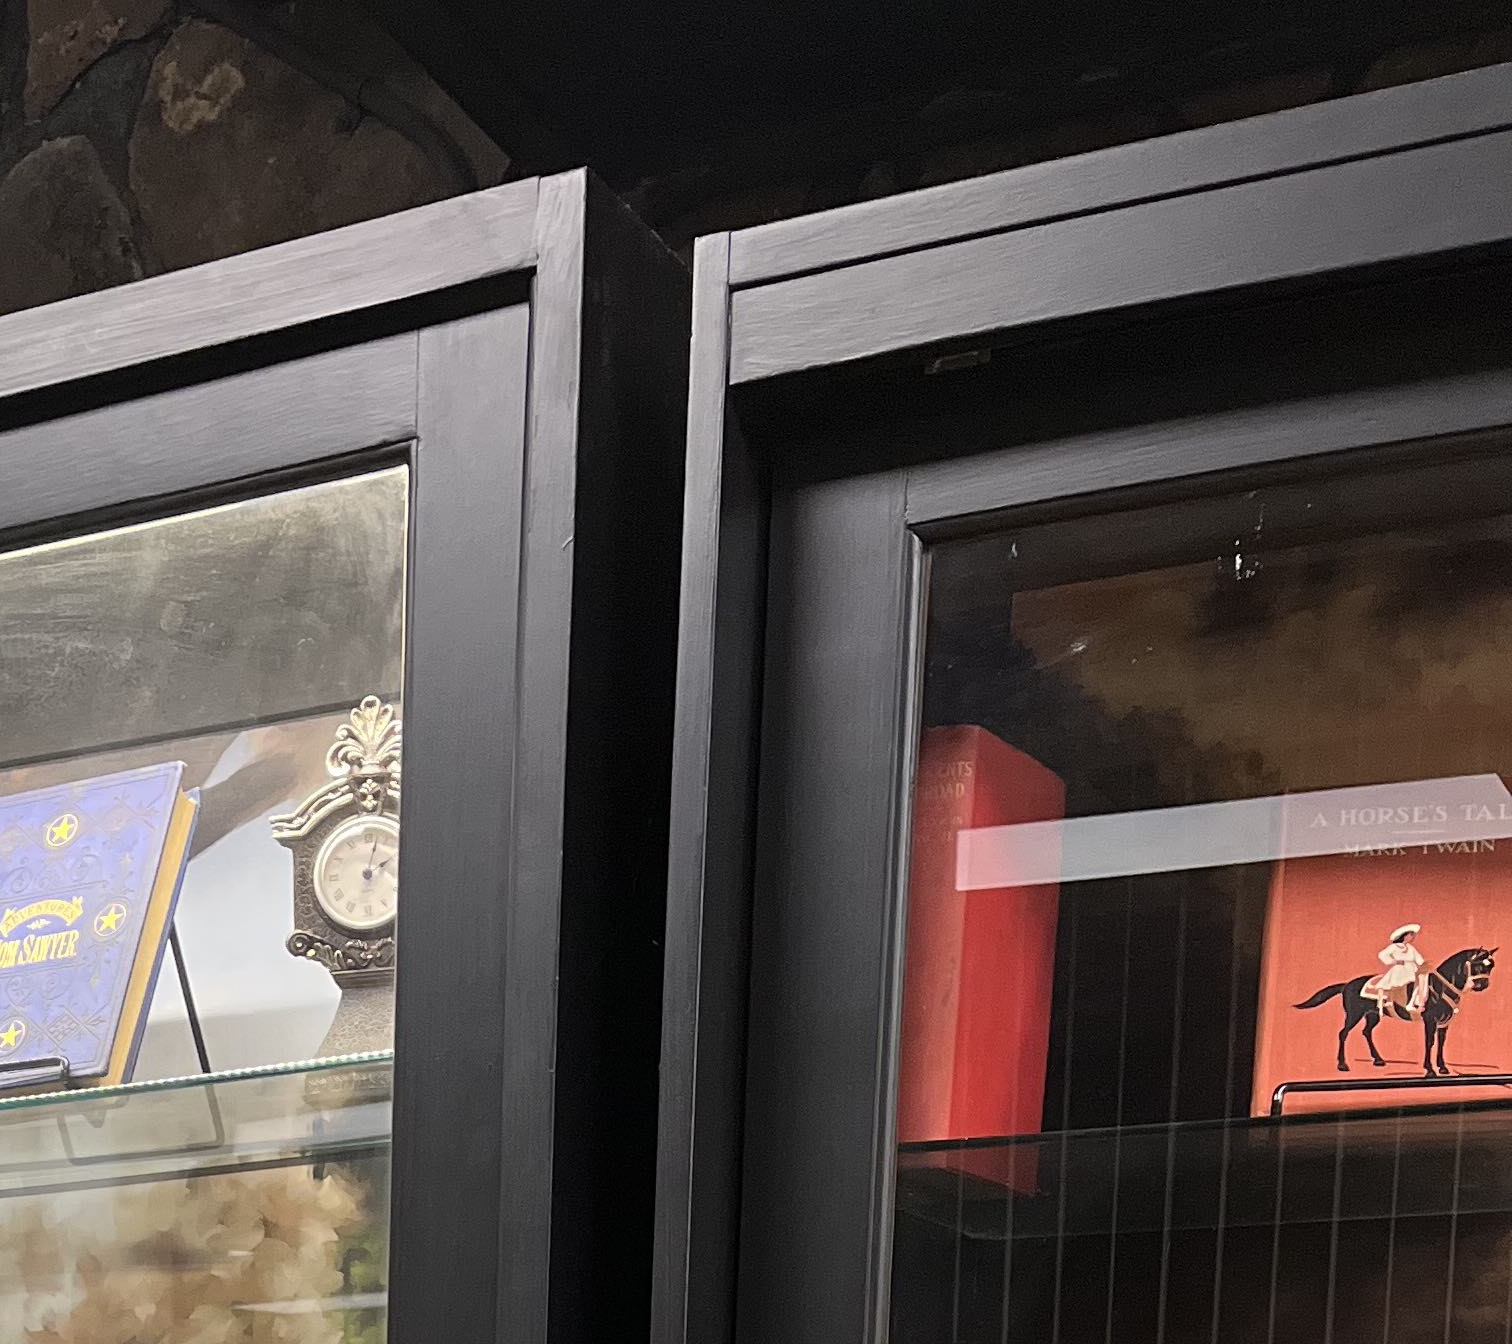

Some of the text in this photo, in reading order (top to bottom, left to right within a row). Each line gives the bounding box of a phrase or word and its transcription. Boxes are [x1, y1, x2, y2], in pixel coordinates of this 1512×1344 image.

[1310, 802, 1512, 829] A HORSE'S TAL
[1420, 838, 1496, 856] TWAIN
[17, 929, 81, 965] SAWYER
